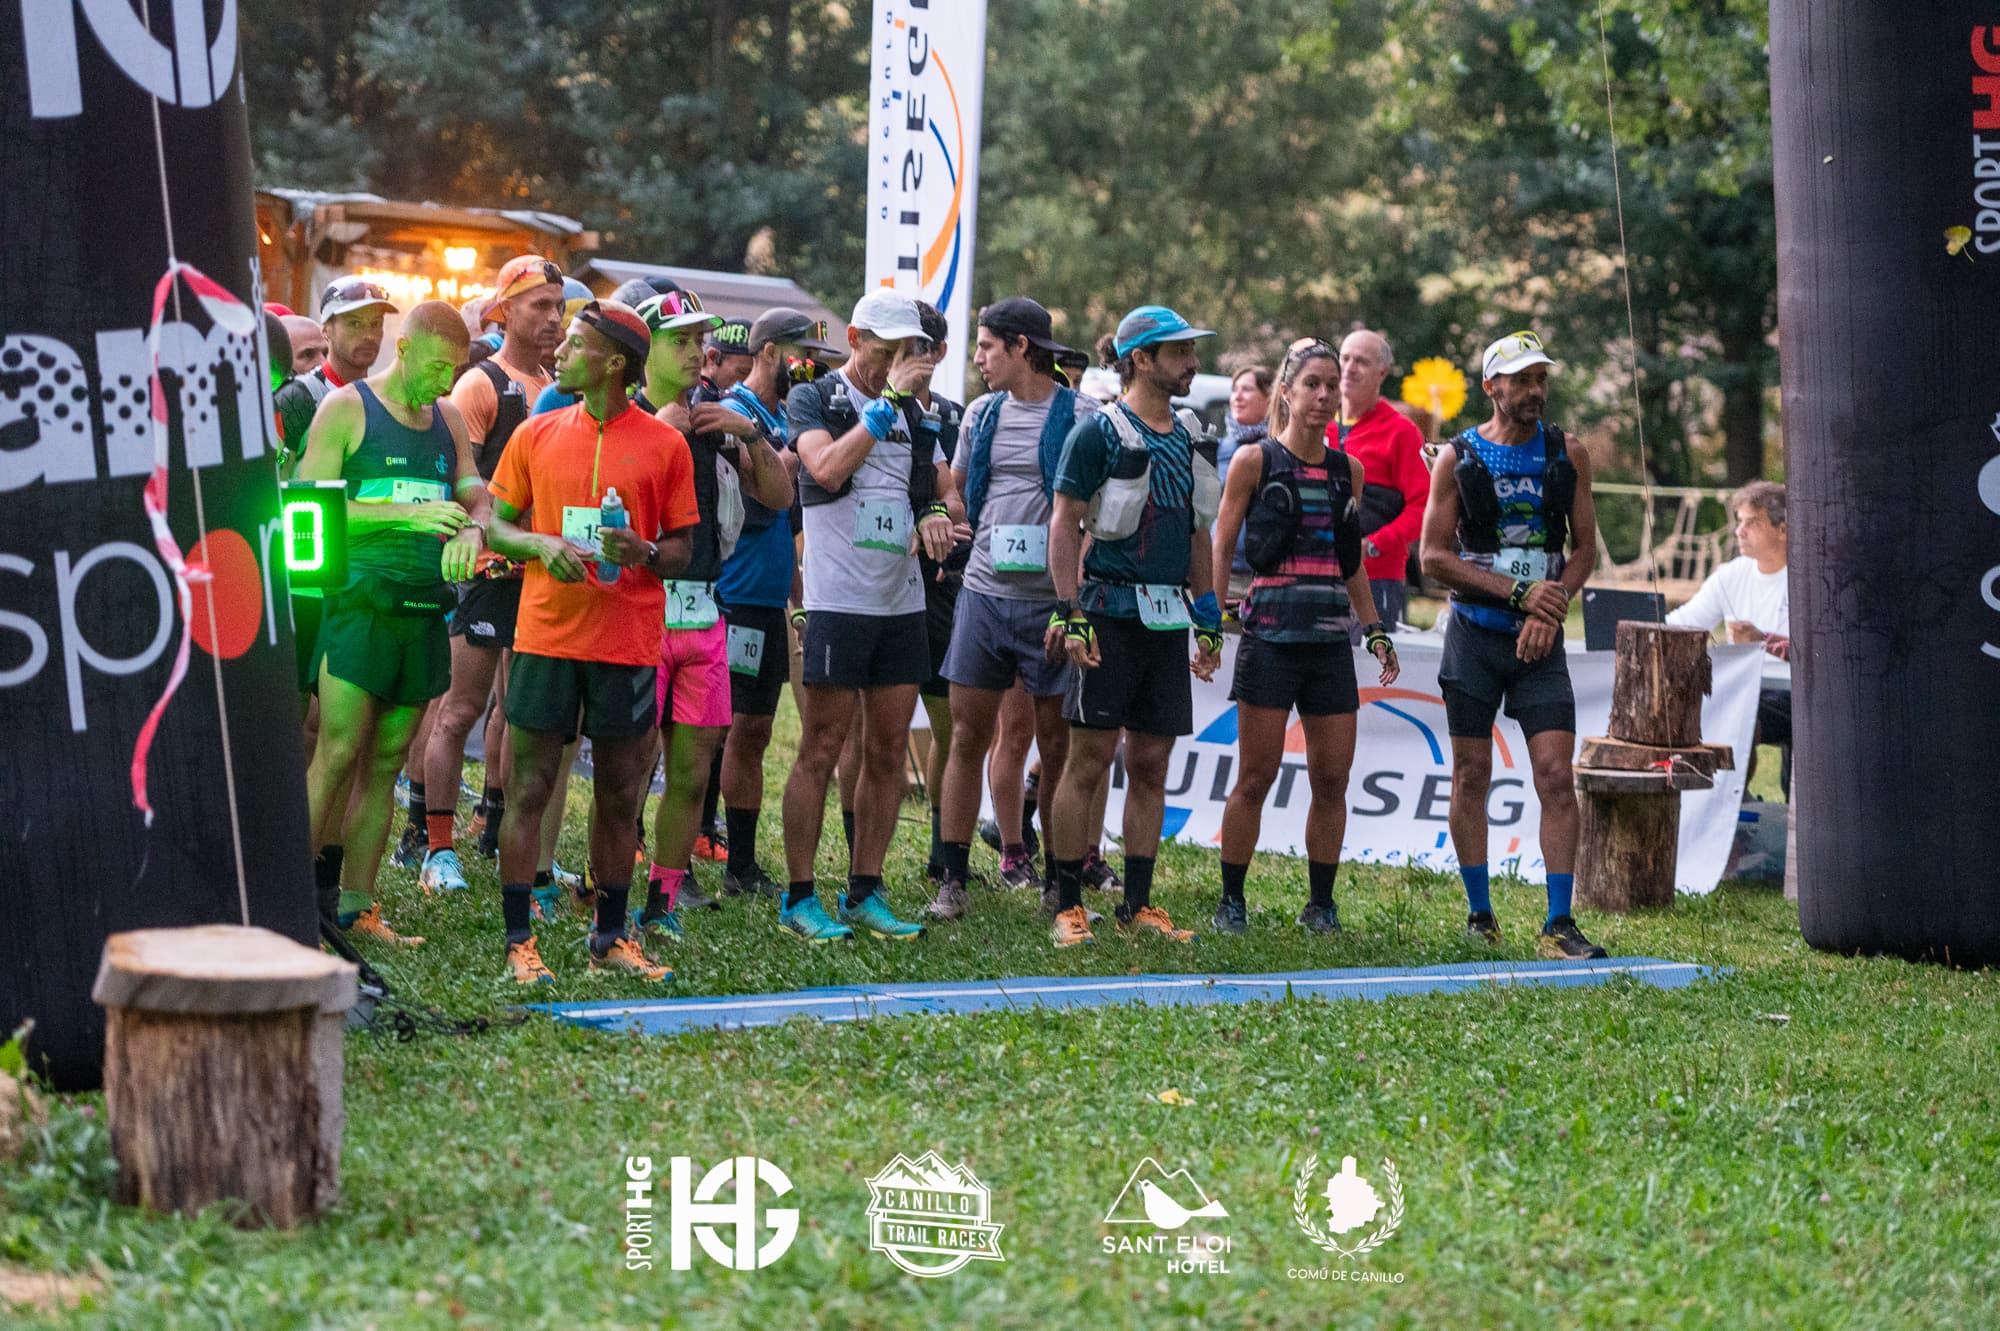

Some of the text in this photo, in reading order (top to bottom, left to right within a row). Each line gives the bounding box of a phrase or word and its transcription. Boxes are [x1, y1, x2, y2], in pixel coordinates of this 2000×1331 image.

[875, 516, 894, 532] 14
[1006, 538, 1028, 553] 74
[1510, 560, 1531, 576] 88
[685, 595, 696, 611] 2
[1154, 599, 1169, 614] 11
[744, 640, 758, 658] 10
